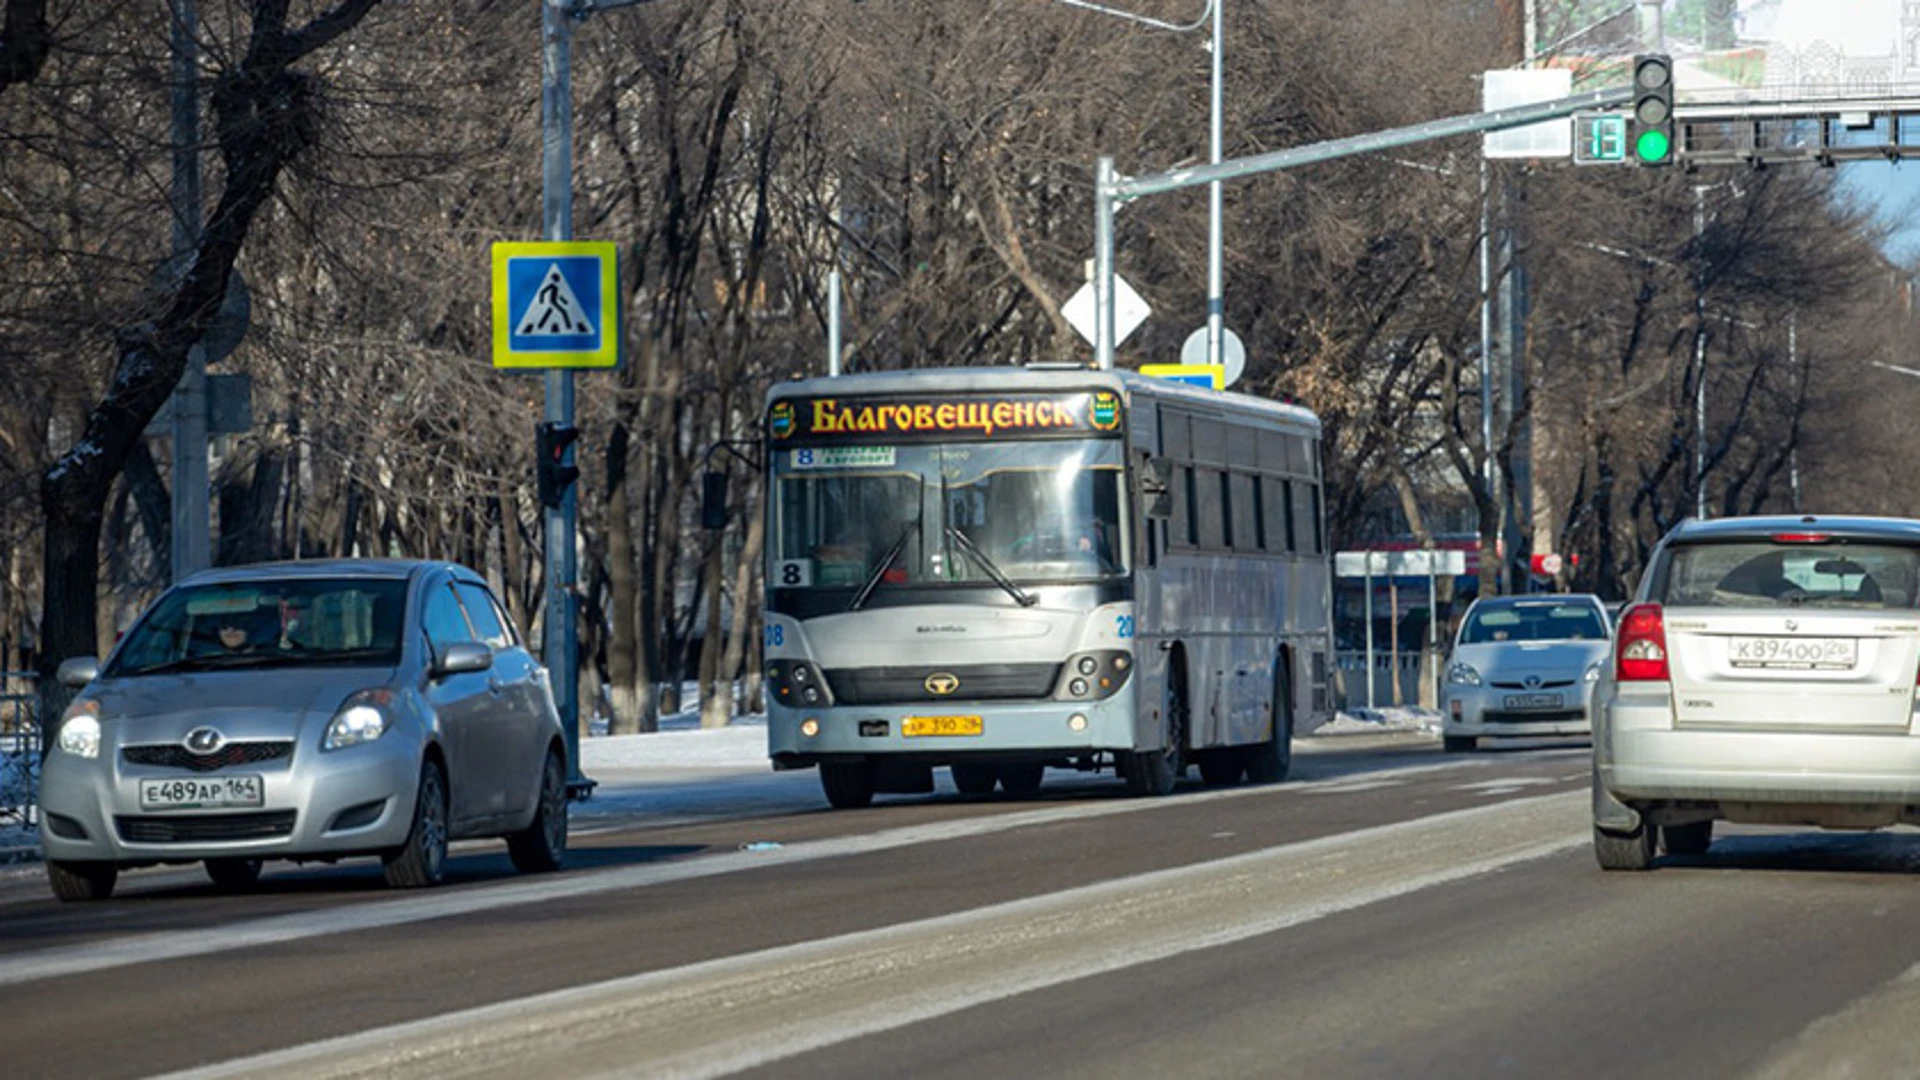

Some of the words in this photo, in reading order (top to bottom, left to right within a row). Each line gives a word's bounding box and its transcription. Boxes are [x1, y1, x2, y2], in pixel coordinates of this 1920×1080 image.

[797, 448, 814, 465] 8
[783, 562, 801, 584] 8
[147, 781, 222, 802] Е489АР
[226, 779, 256, 795] 164
